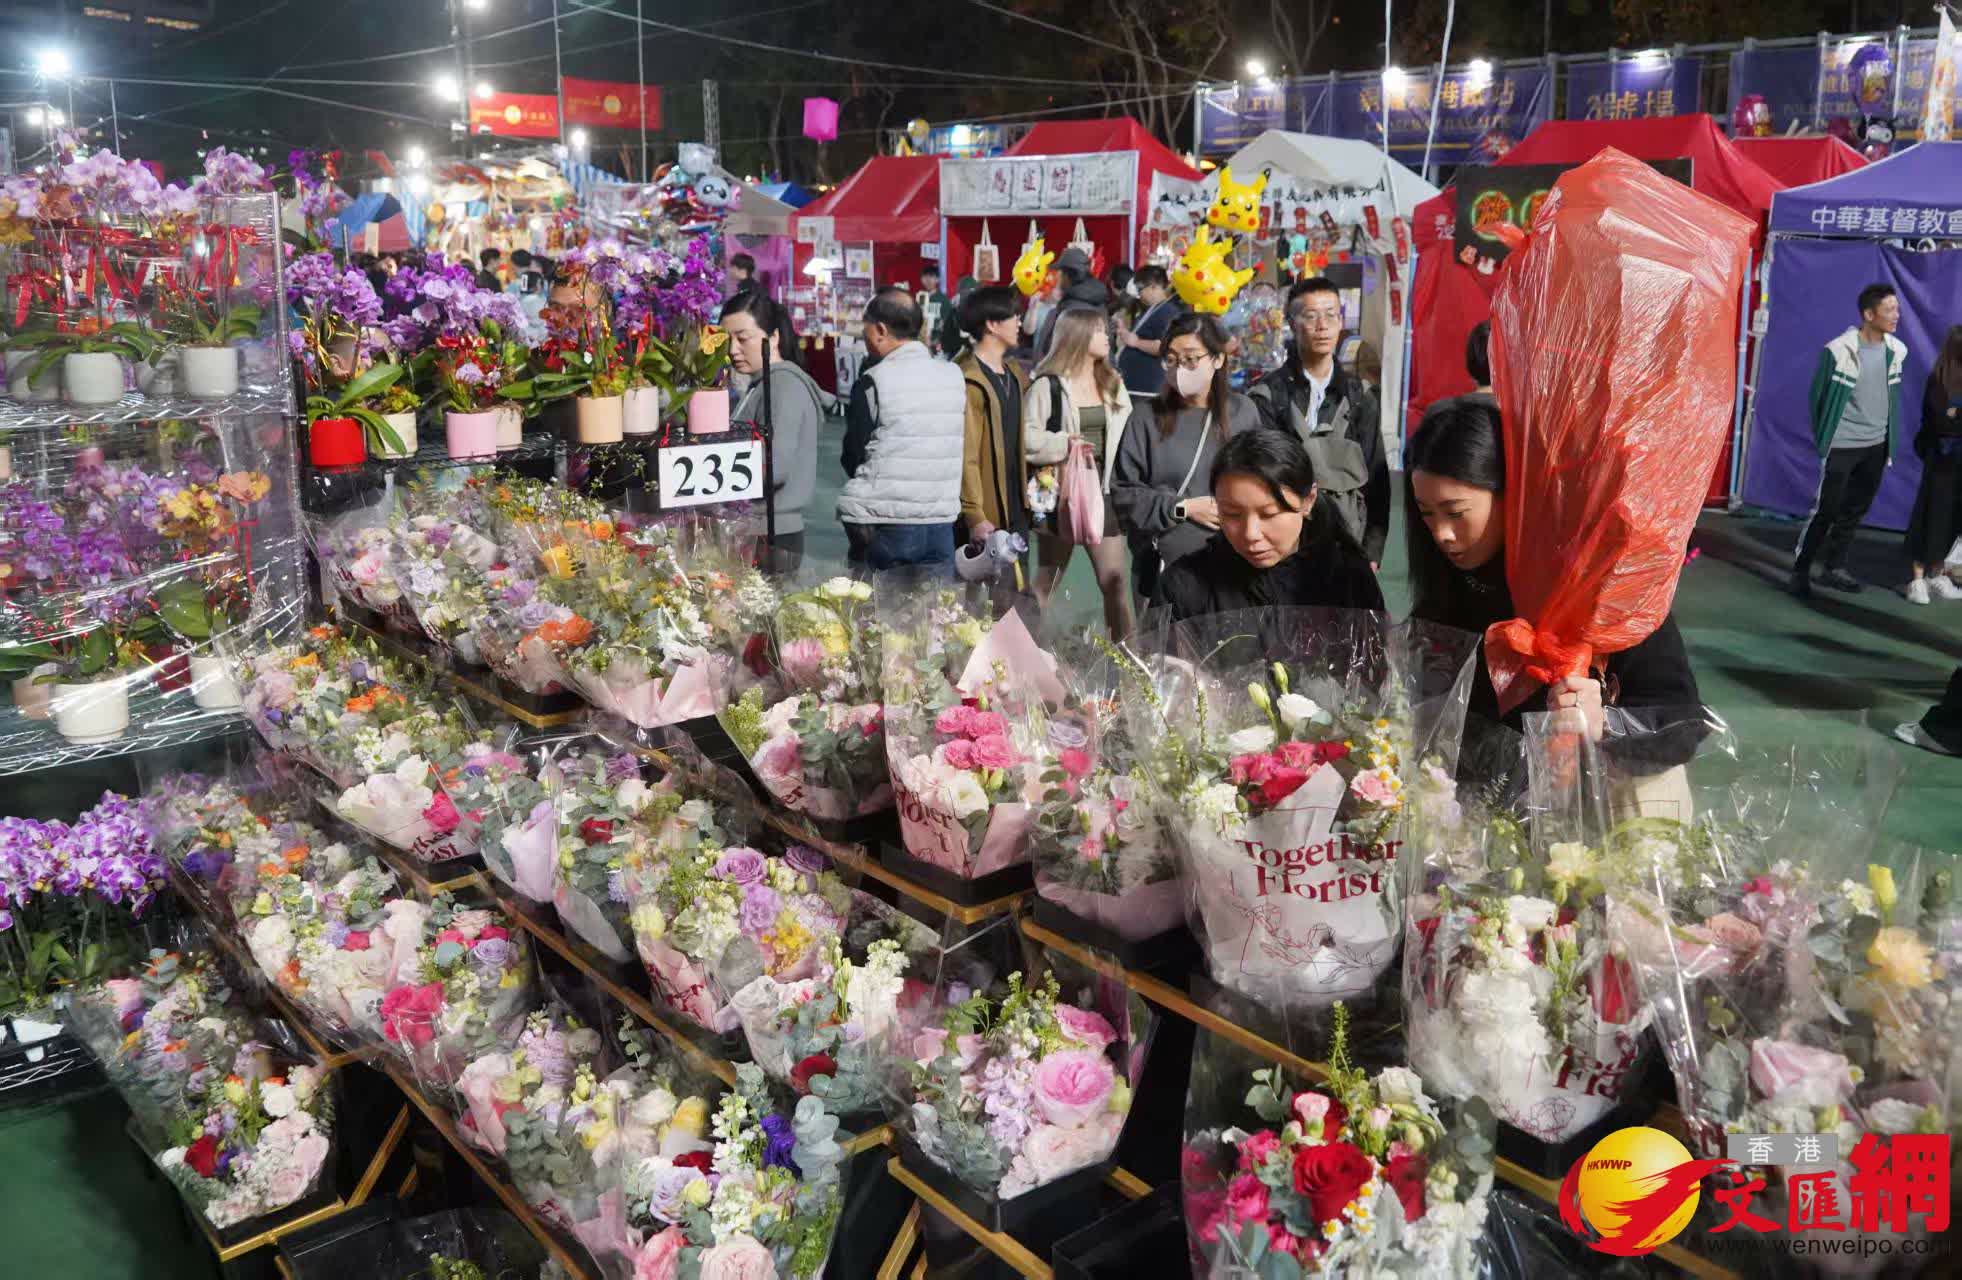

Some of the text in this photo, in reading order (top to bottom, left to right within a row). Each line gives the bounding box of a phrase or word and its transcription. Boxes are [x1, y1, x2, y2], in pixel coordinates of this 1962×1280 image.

[673, 451, 753, 497] 235
[1235, 833, 1404, 875] Together
[1254, 864, 1386, 903] Florist
